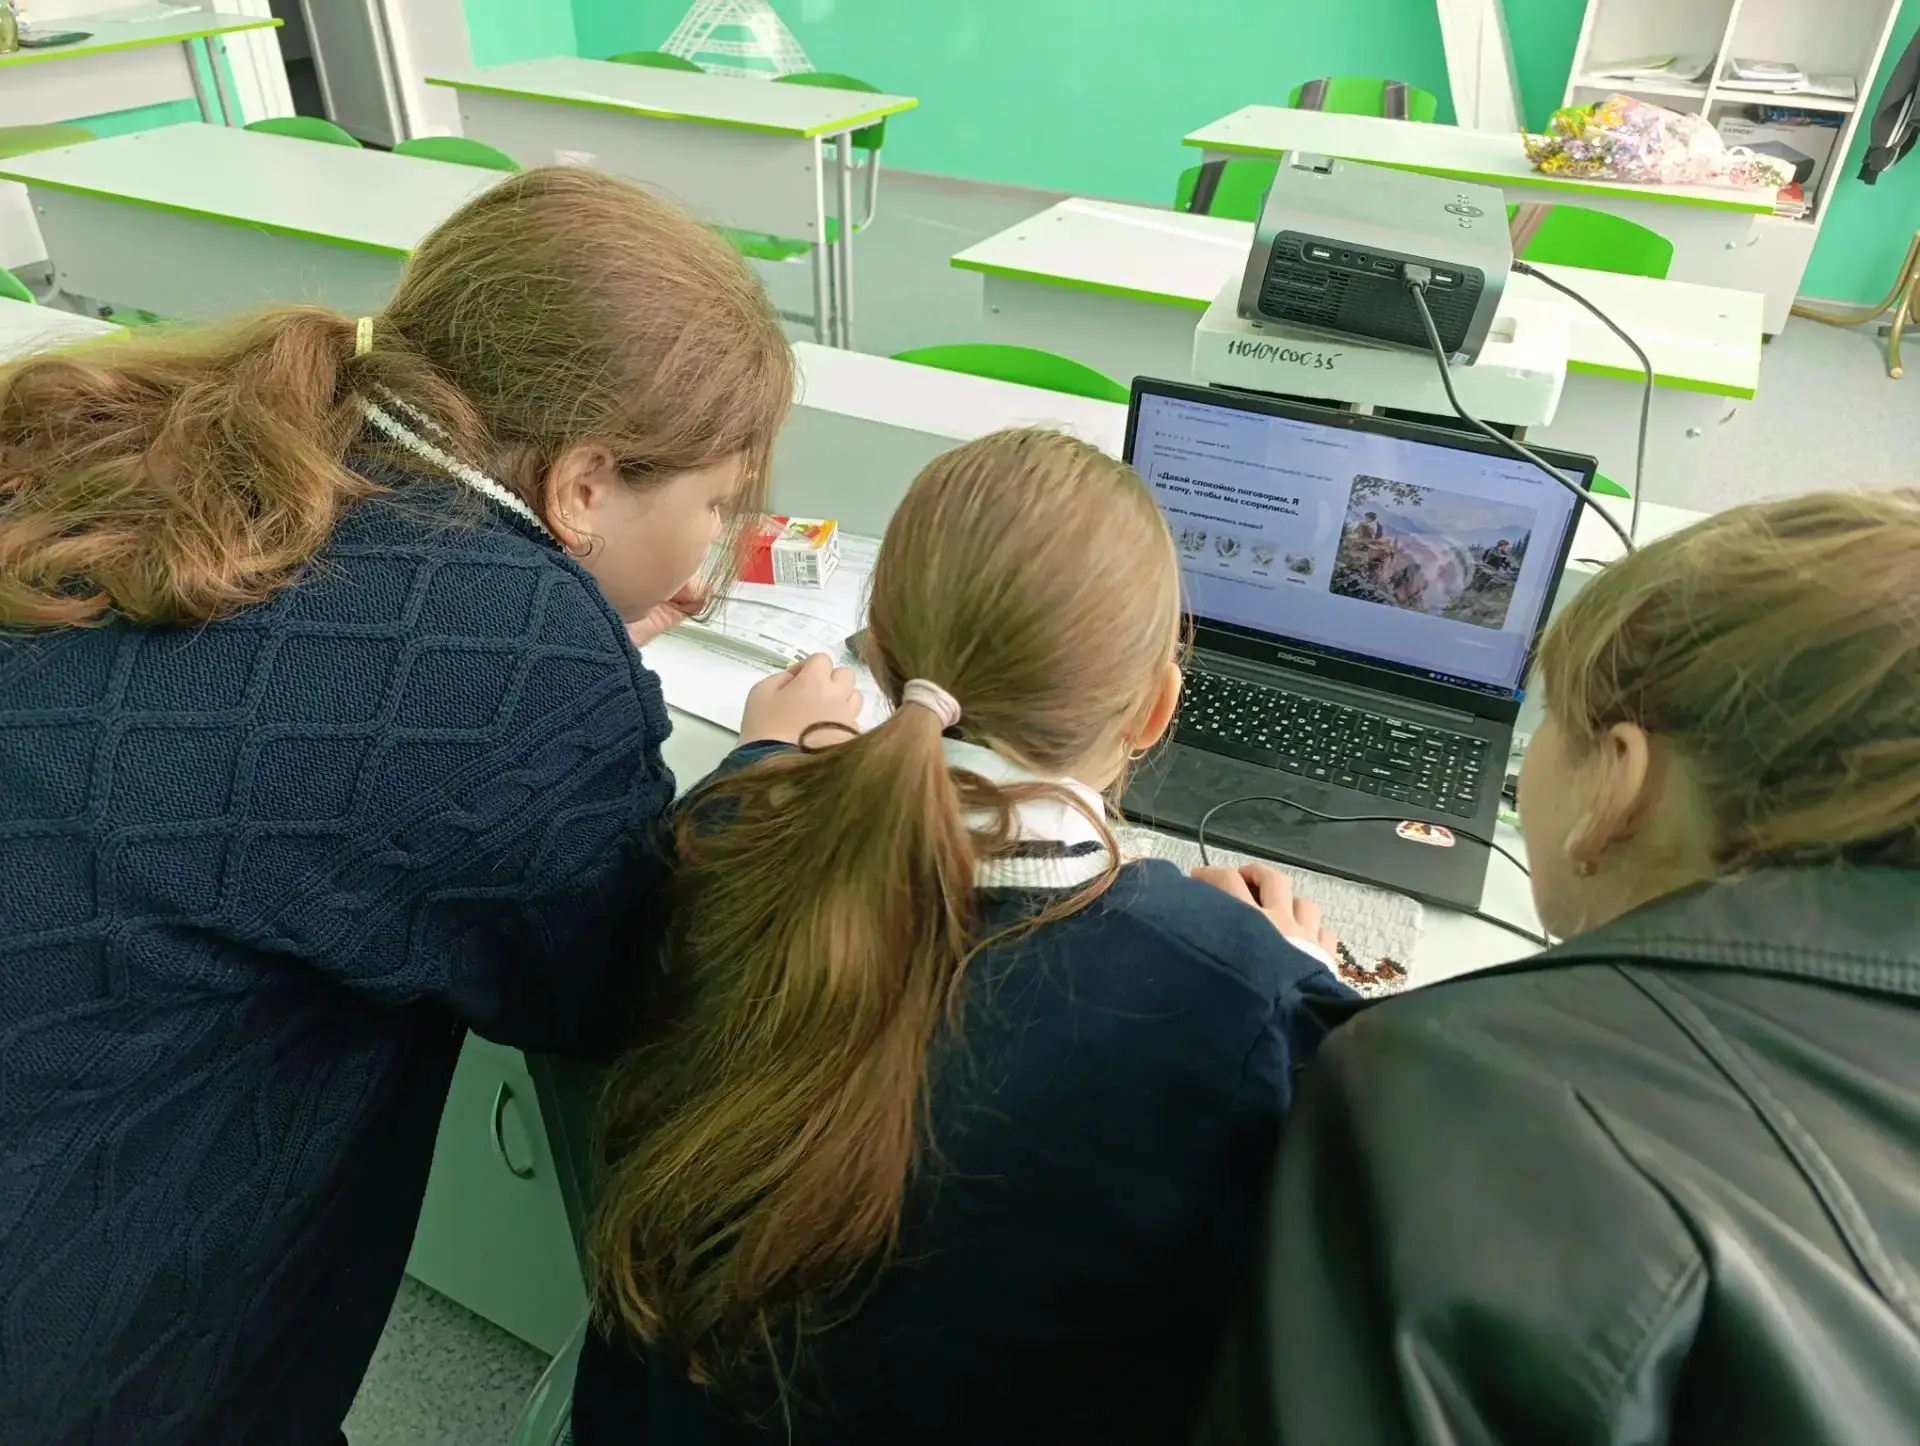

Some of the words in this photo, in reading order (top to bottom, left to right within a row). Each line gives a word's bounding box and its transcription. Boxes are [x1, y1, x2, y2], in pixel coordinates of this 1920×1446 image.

[1155, 482, 1167, 490] не
[1169, 485, 1192, 496] хочу,
[1194, 489, 1222, 500] чтобы
[1223, 496, 1239, 504] мы
[1157, 471, 1190, 484] «Давай
[1192, 478, 1236, 493] спокойно
[1237, 487, 1290, 504] поговорим.
[1292, 498, 1300, 506] Я
